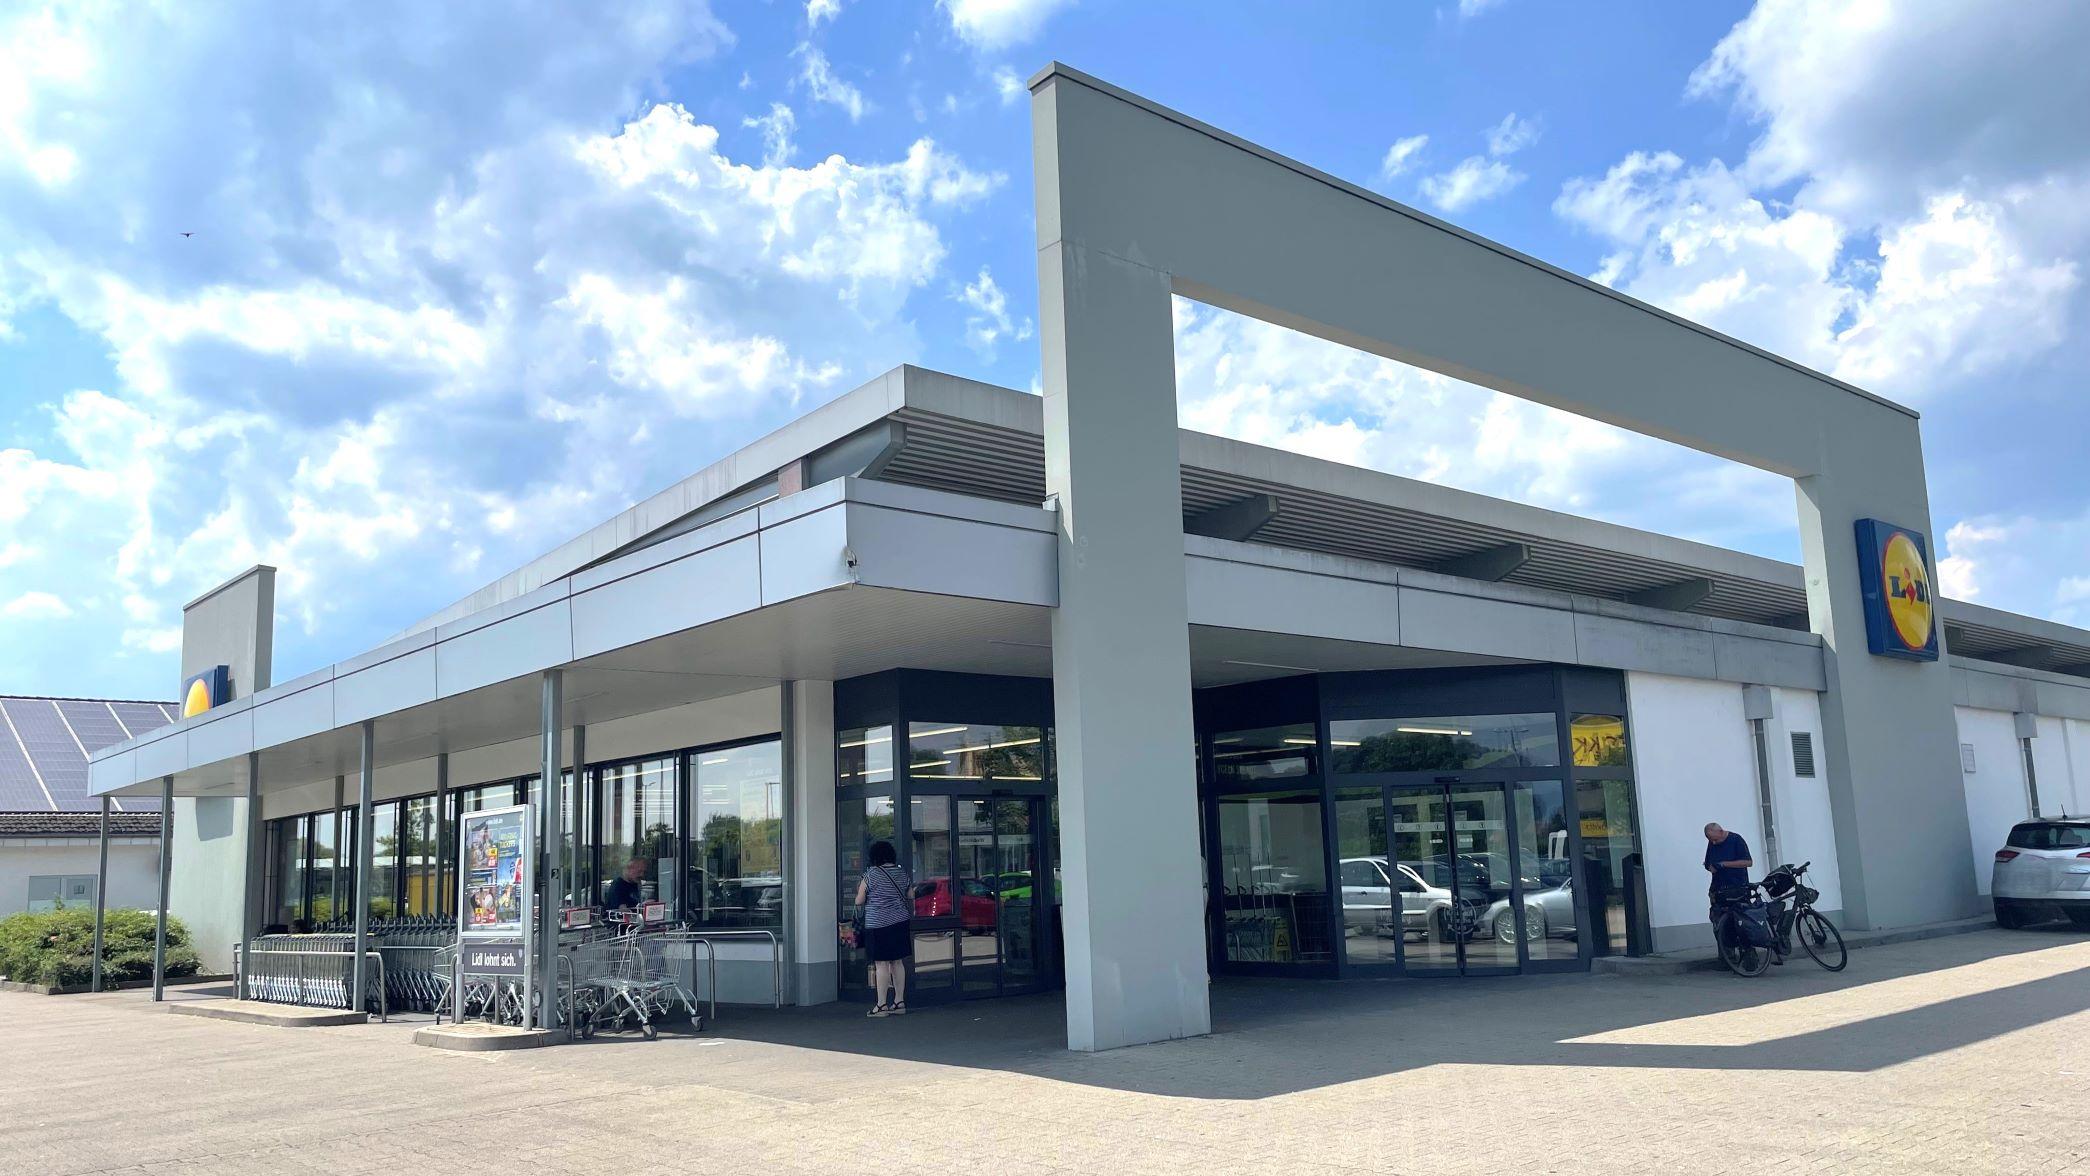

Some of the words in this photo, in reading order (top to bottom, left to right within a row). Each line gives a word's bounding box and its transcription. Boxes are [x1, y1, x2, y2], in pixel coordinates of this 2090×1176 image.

[472, 952, 483, 966] Lidl
[484, 952, 500, 967] lohnt
[501, 952, 517, 967] sich.
